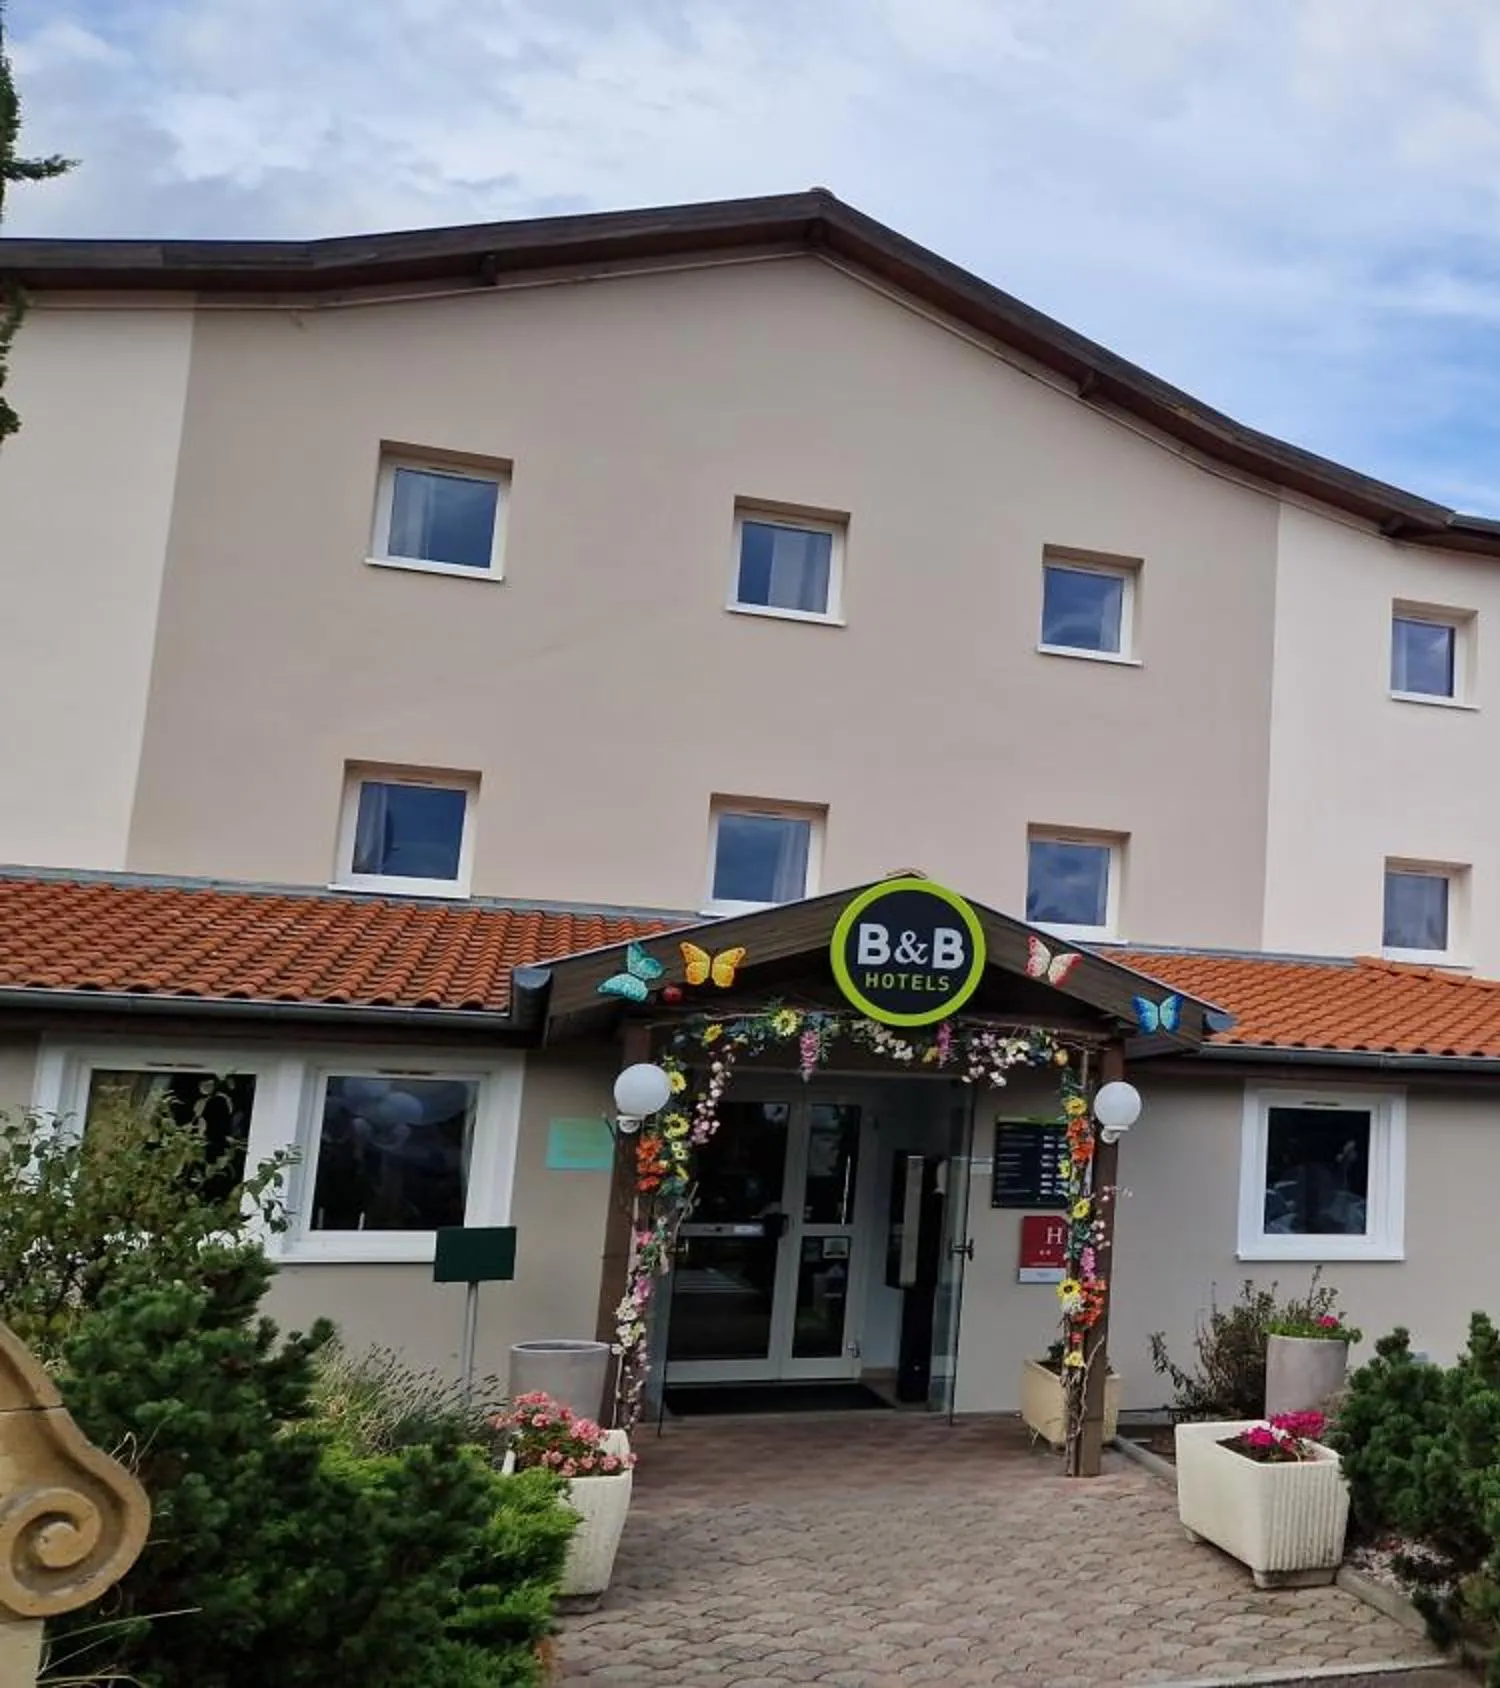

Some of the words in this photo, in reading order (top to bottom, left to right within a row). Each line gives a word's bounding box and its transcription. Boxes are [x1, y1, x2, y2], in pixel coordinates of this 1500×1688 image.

[857, 923, 965, 969] B&B
[865, 973, 950, 991] HOTELS
[1046, 1226, 1064, 1245] H
